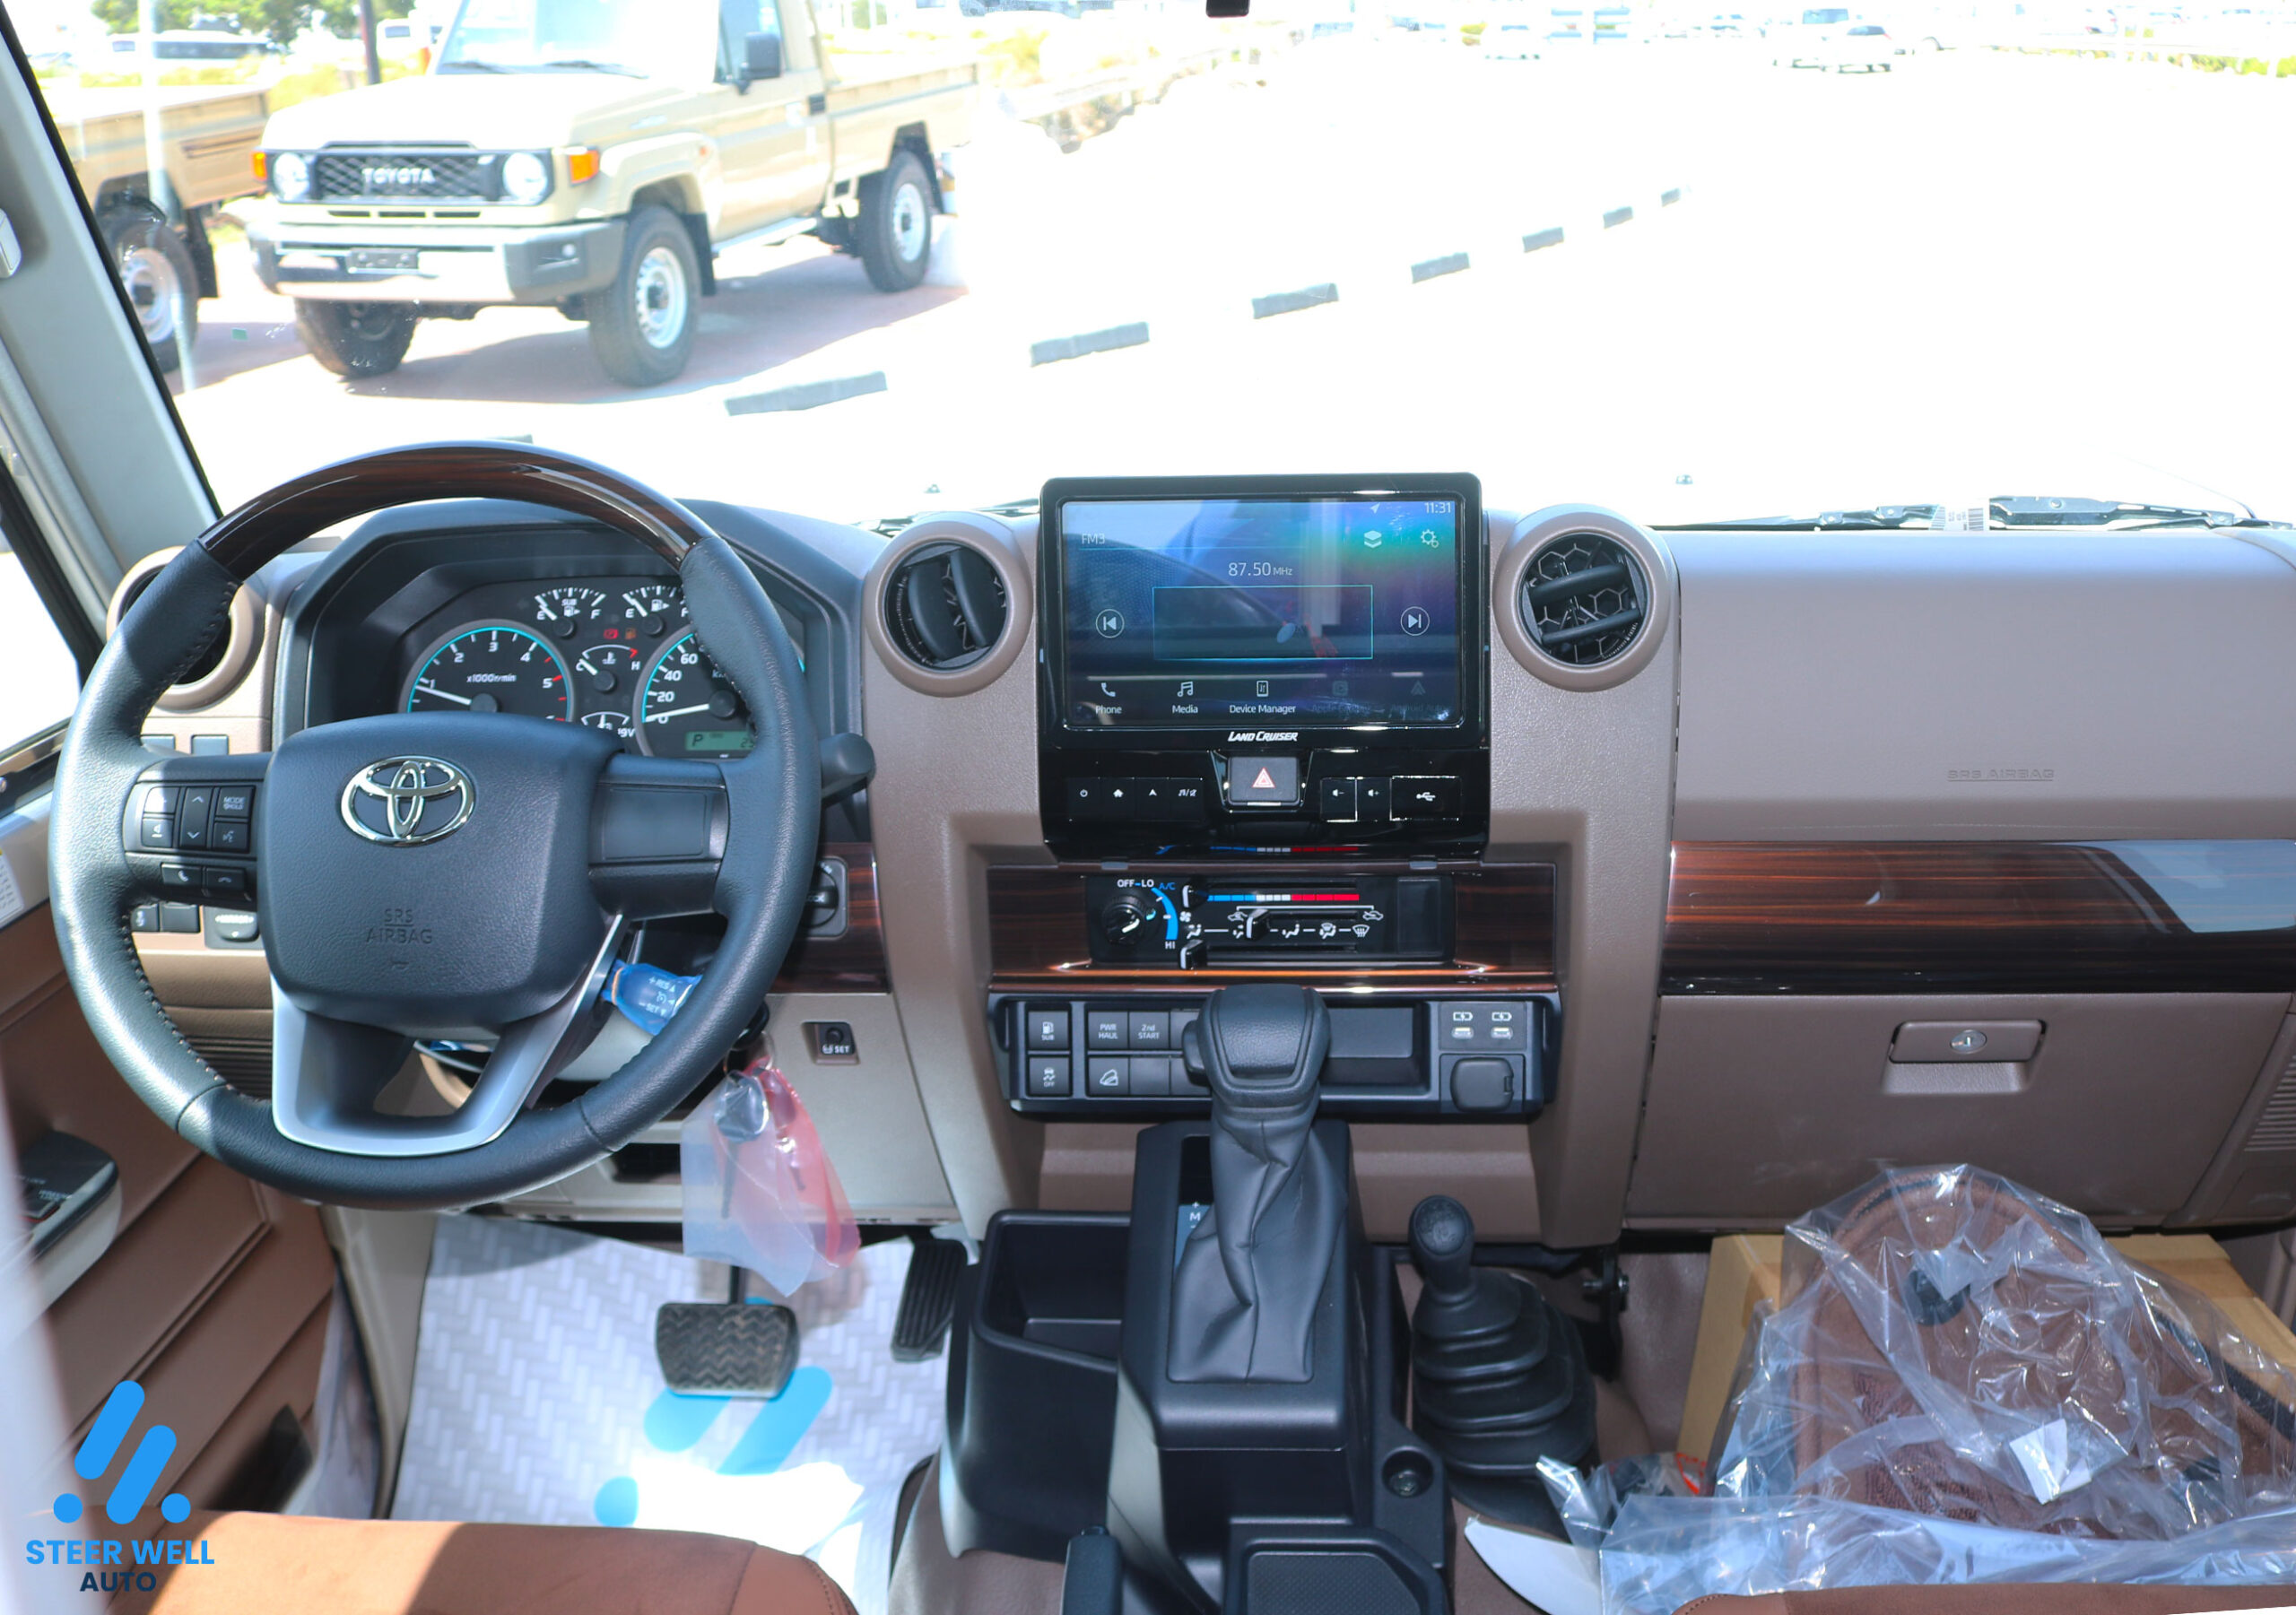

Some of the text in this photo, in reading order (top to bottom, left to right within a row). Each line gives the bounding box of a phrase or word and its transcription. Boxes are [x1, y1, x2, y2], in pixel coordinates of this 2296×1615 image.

[361, 168, 436, 184] TOYOTA
[1424, 502, 1451, 514] 11:31
[1081, 534, 1105, 544] FM3
[1228, 562, 1292, 577] 87.50 MHz
[561, 598, 577, 606] SUB
[591, 609, 601, 620] F
[625, 608, 634, 619] E
[489, 642, 499, 652] 3
[454, 652, 465, 663] 2
[520, 651, 531, 662] 4
[681, 654, 698, 664] 60
[631, 661, 640, 671] H
[664, 671, 682, 682] 40
[543, 678, 552, 689] 5
[657, 691, 674, 702] 20
[1095, 705, 1121, 715] Phone
[1172, 705, 1198, 714] Media
[1229, 704, 1296, 716] Device Manager
[692, 734, 703, 746] P
[1228, 731, 1298, 742] LAND CRUISER
[1948, 768, 2055, 779] SRS AIRBAG
[1159, 882, 1176, 890] A/C
[384, 907, 414, 923] SRS
[366, 928, 432, 944] AIRBAG
[1165, 941, 1176, 950] HI
[1100, 1023, 1117, 1031] PWR
[1141, 1024, 1156, 1032] 2nd
[1098, 1032, 1118, 1040] HAUL
[1137, 1032, 1161, 1040] START
[834, 1045, 850, 1054] SET
[1189, 1211, 1201, 1221] M
